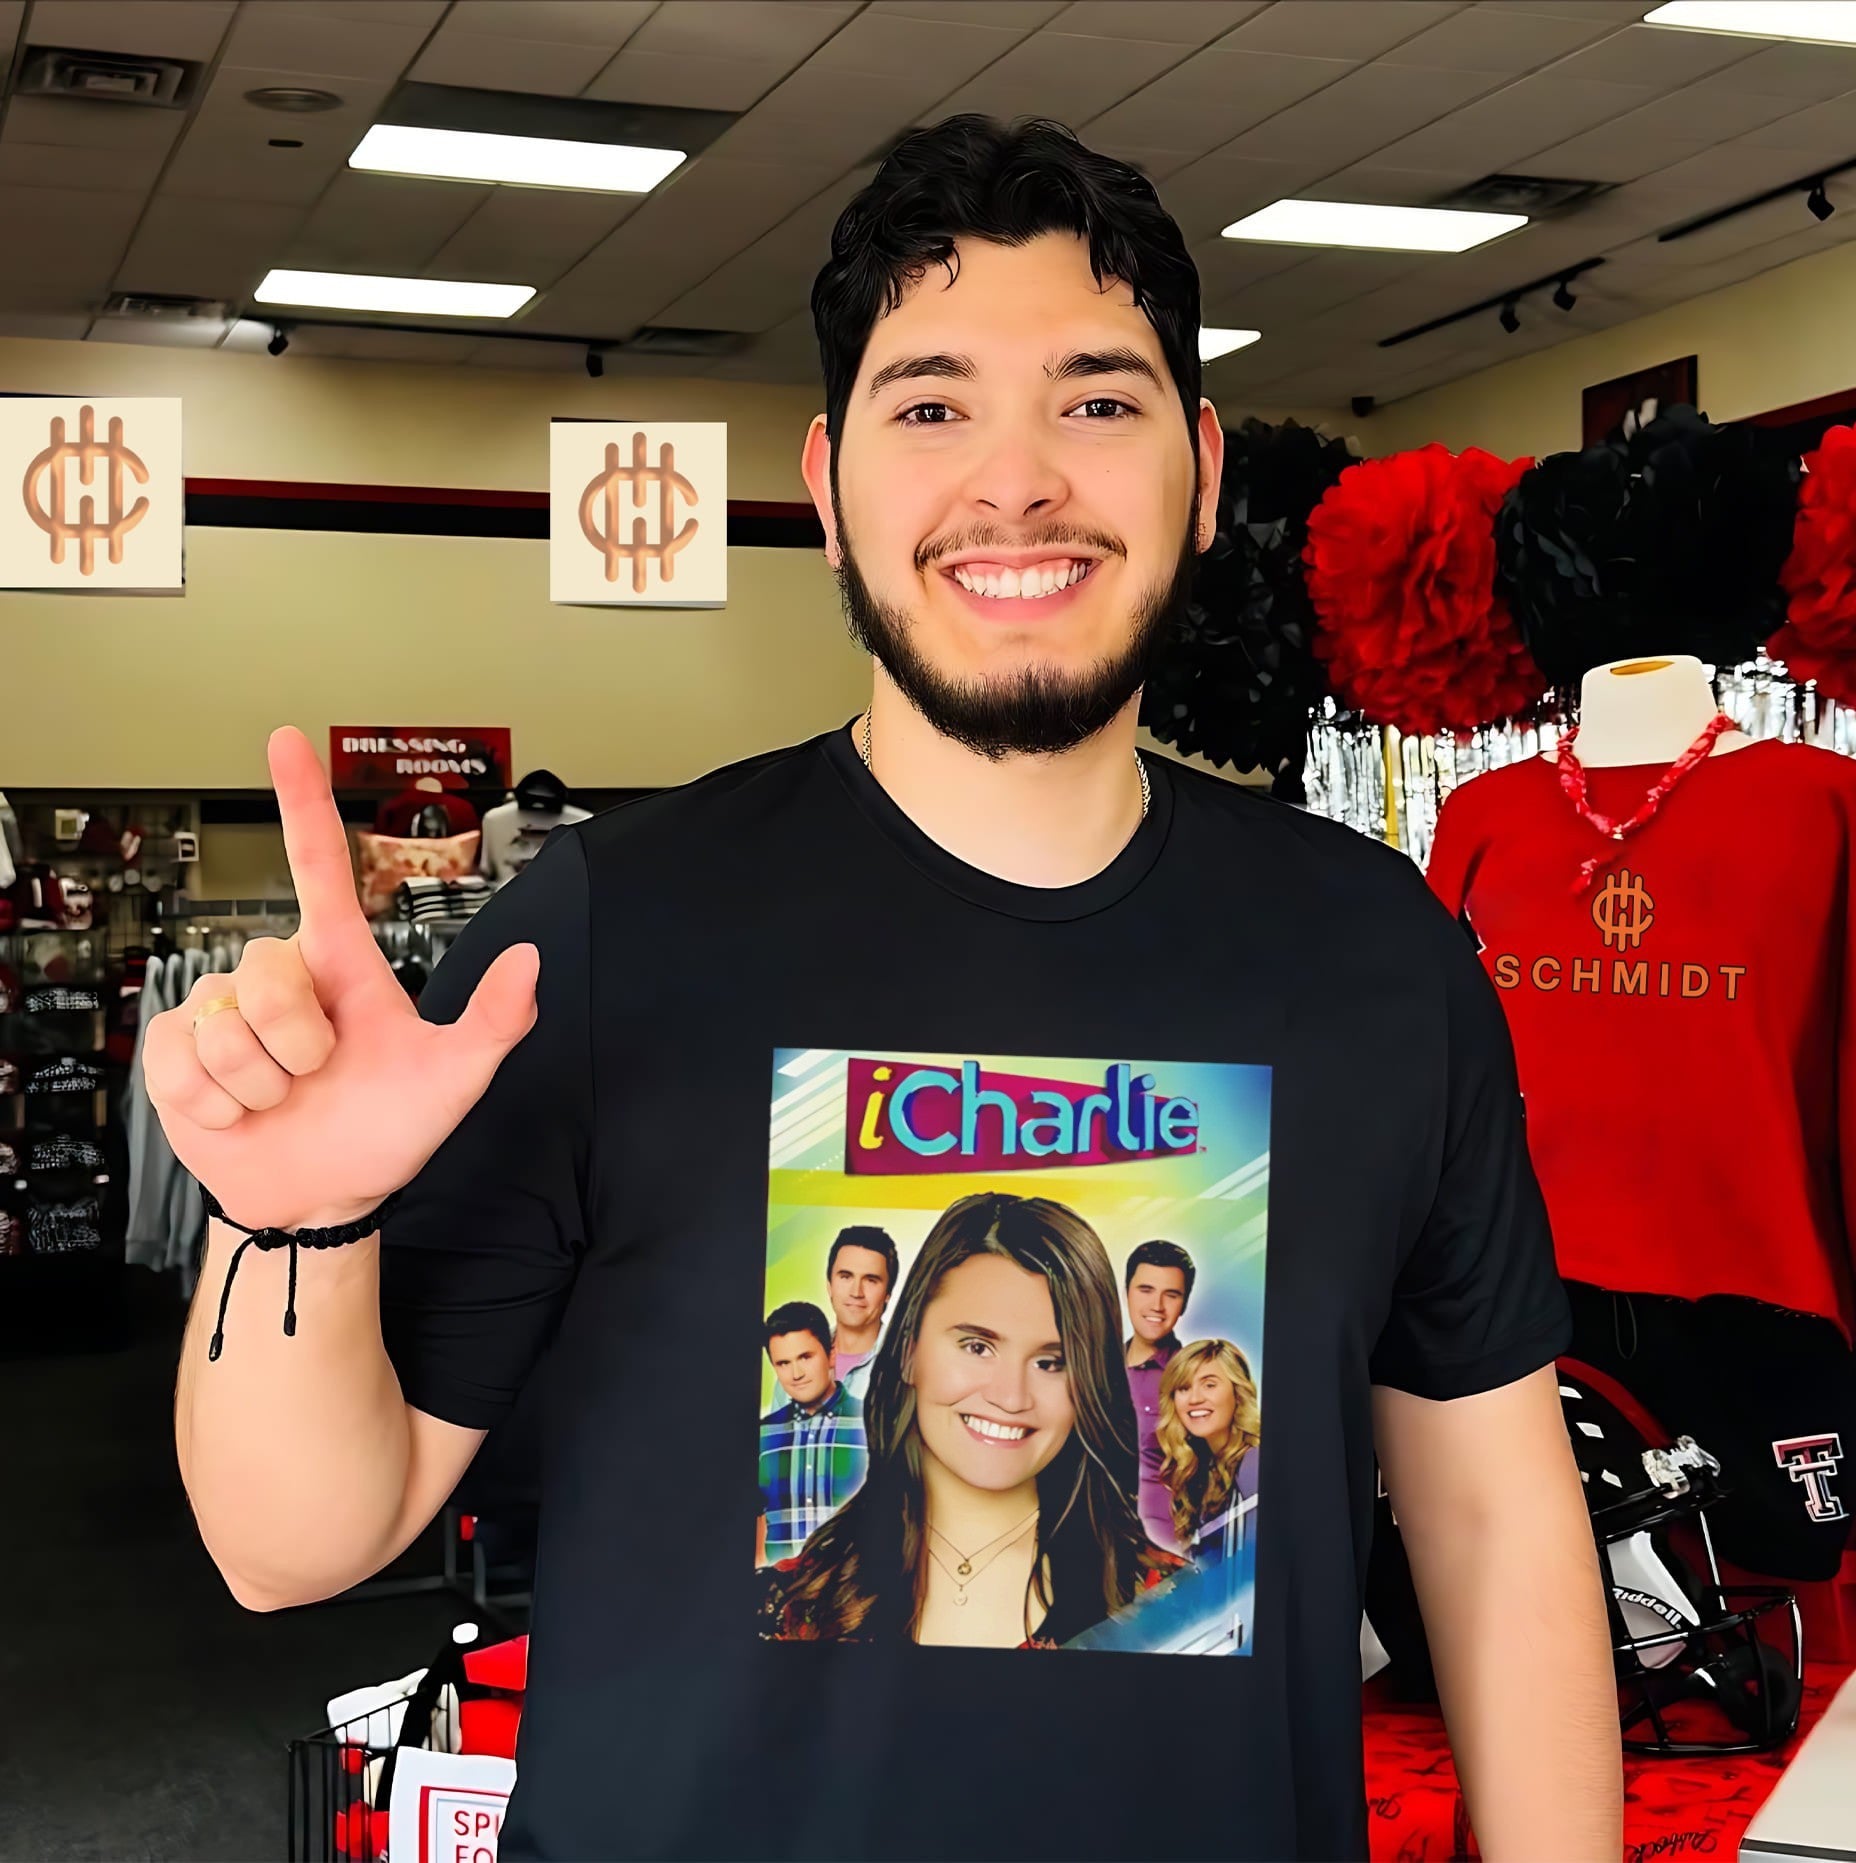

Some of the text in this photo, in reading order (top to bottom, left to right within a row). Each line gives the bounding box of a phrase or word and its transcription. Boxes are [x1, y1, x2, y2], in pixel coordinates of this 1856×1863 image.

[342, 737, 467, 754] DRESSING
[396, 758, 488, 775] ROOMS
[1494, 954, 1747, 1001] SCHMIDT
[858, 1060, 1200, 1156] iCharlie
